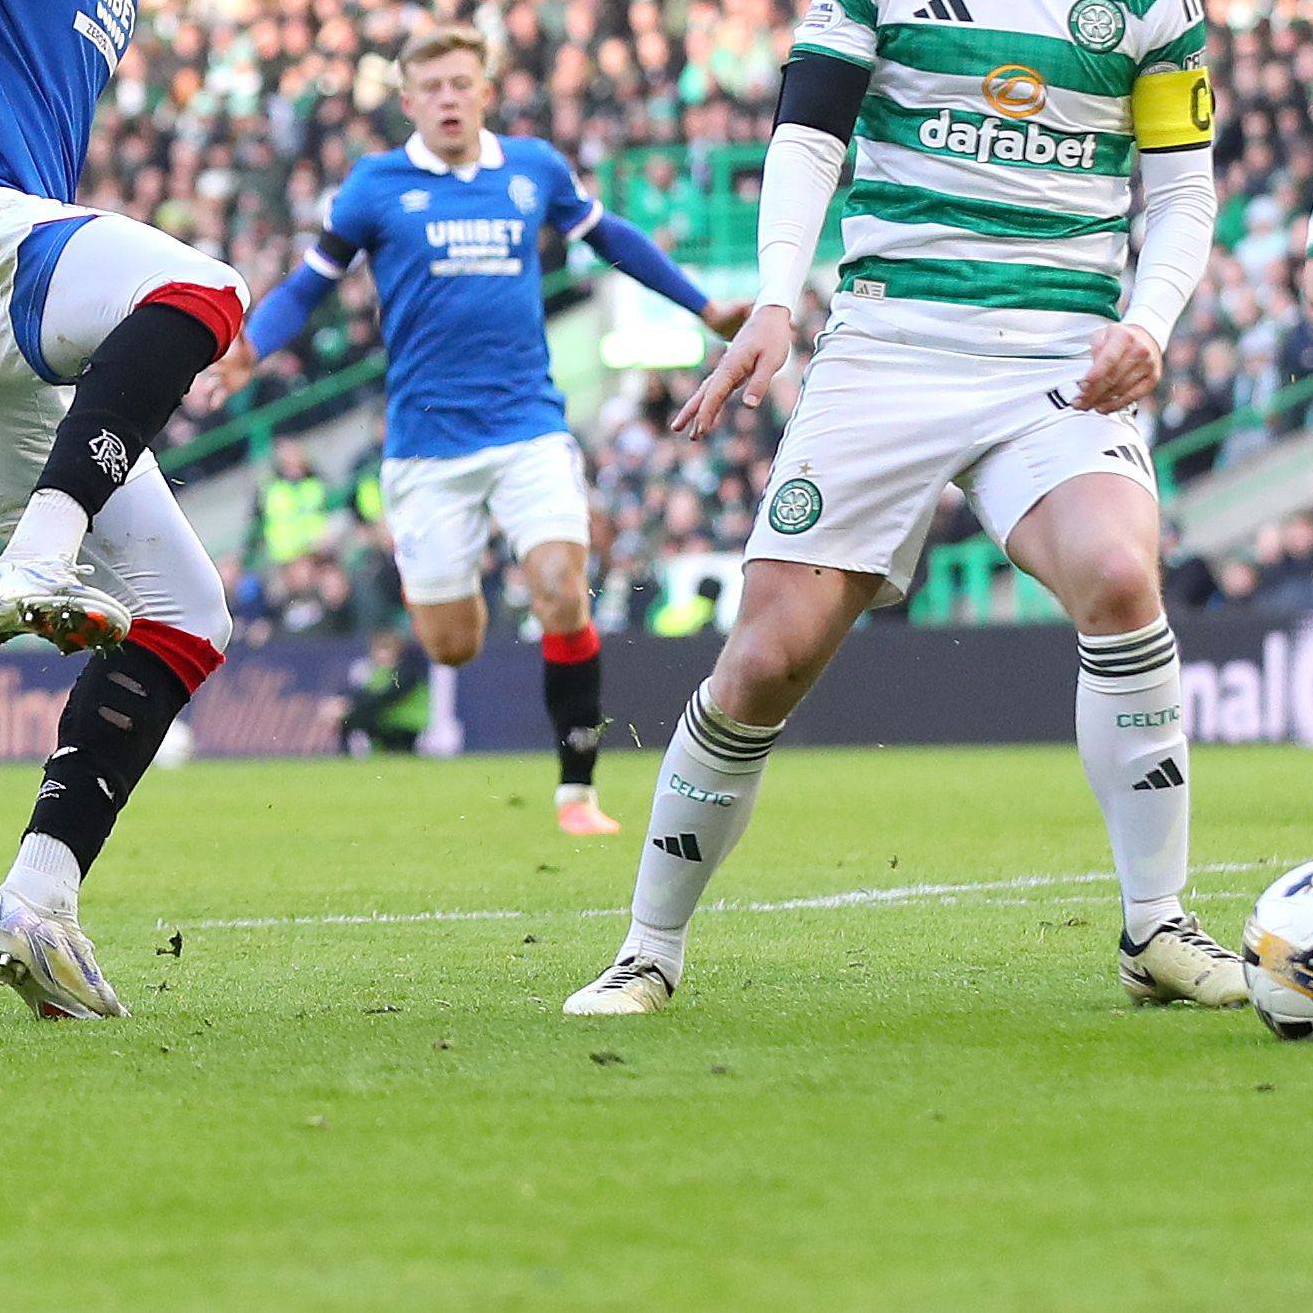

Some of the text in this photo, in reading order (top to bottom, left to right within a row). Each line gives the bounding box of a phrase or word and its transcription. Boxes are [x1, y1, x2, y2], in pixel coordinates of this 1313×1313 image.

[918, 108, 1096, 169] dafabet
[425, 219, 525, 248] UNIBET
[1116, 704, 1181, 729] CELTIC
[670, 773, 735, 807] CELTIC
